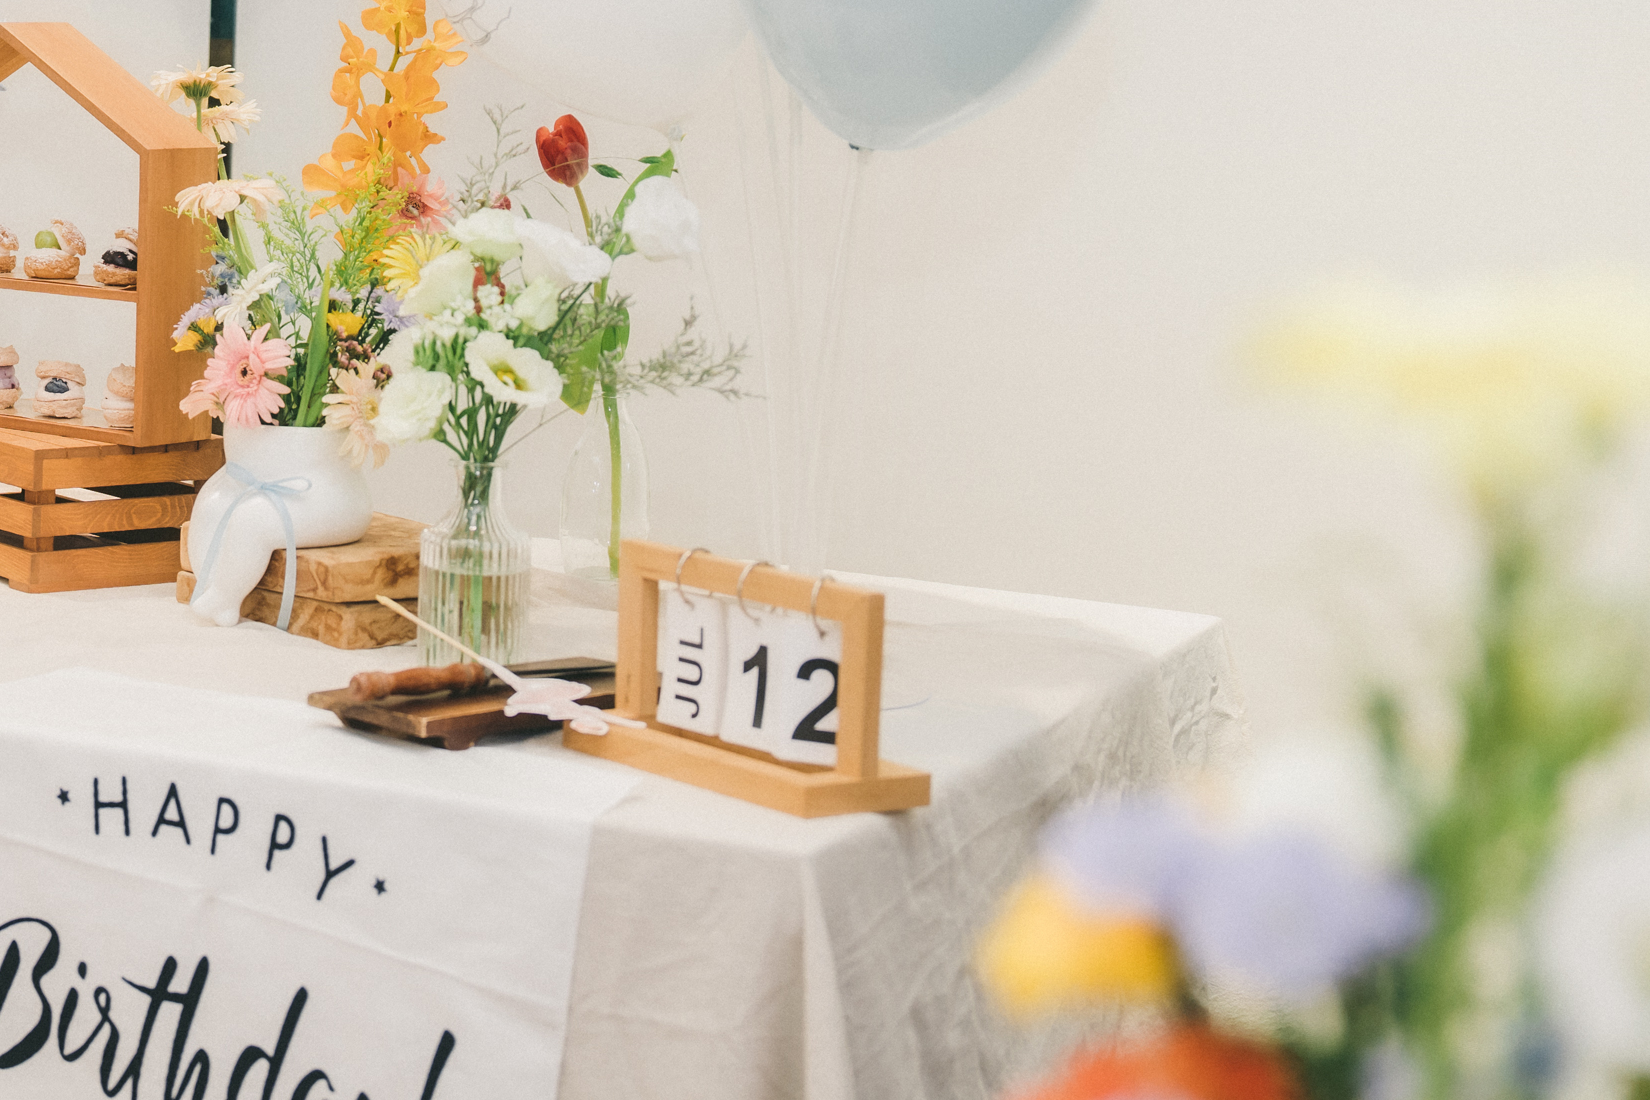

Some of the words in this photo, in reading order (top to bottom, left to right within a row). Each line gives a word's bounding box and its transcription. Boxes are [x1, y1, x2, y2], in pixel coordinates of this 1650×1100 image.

[674, 627, 704, 719] JUL
[743, 645, 840, 745] 12
[93, 775, 356, 901] HAPPY
